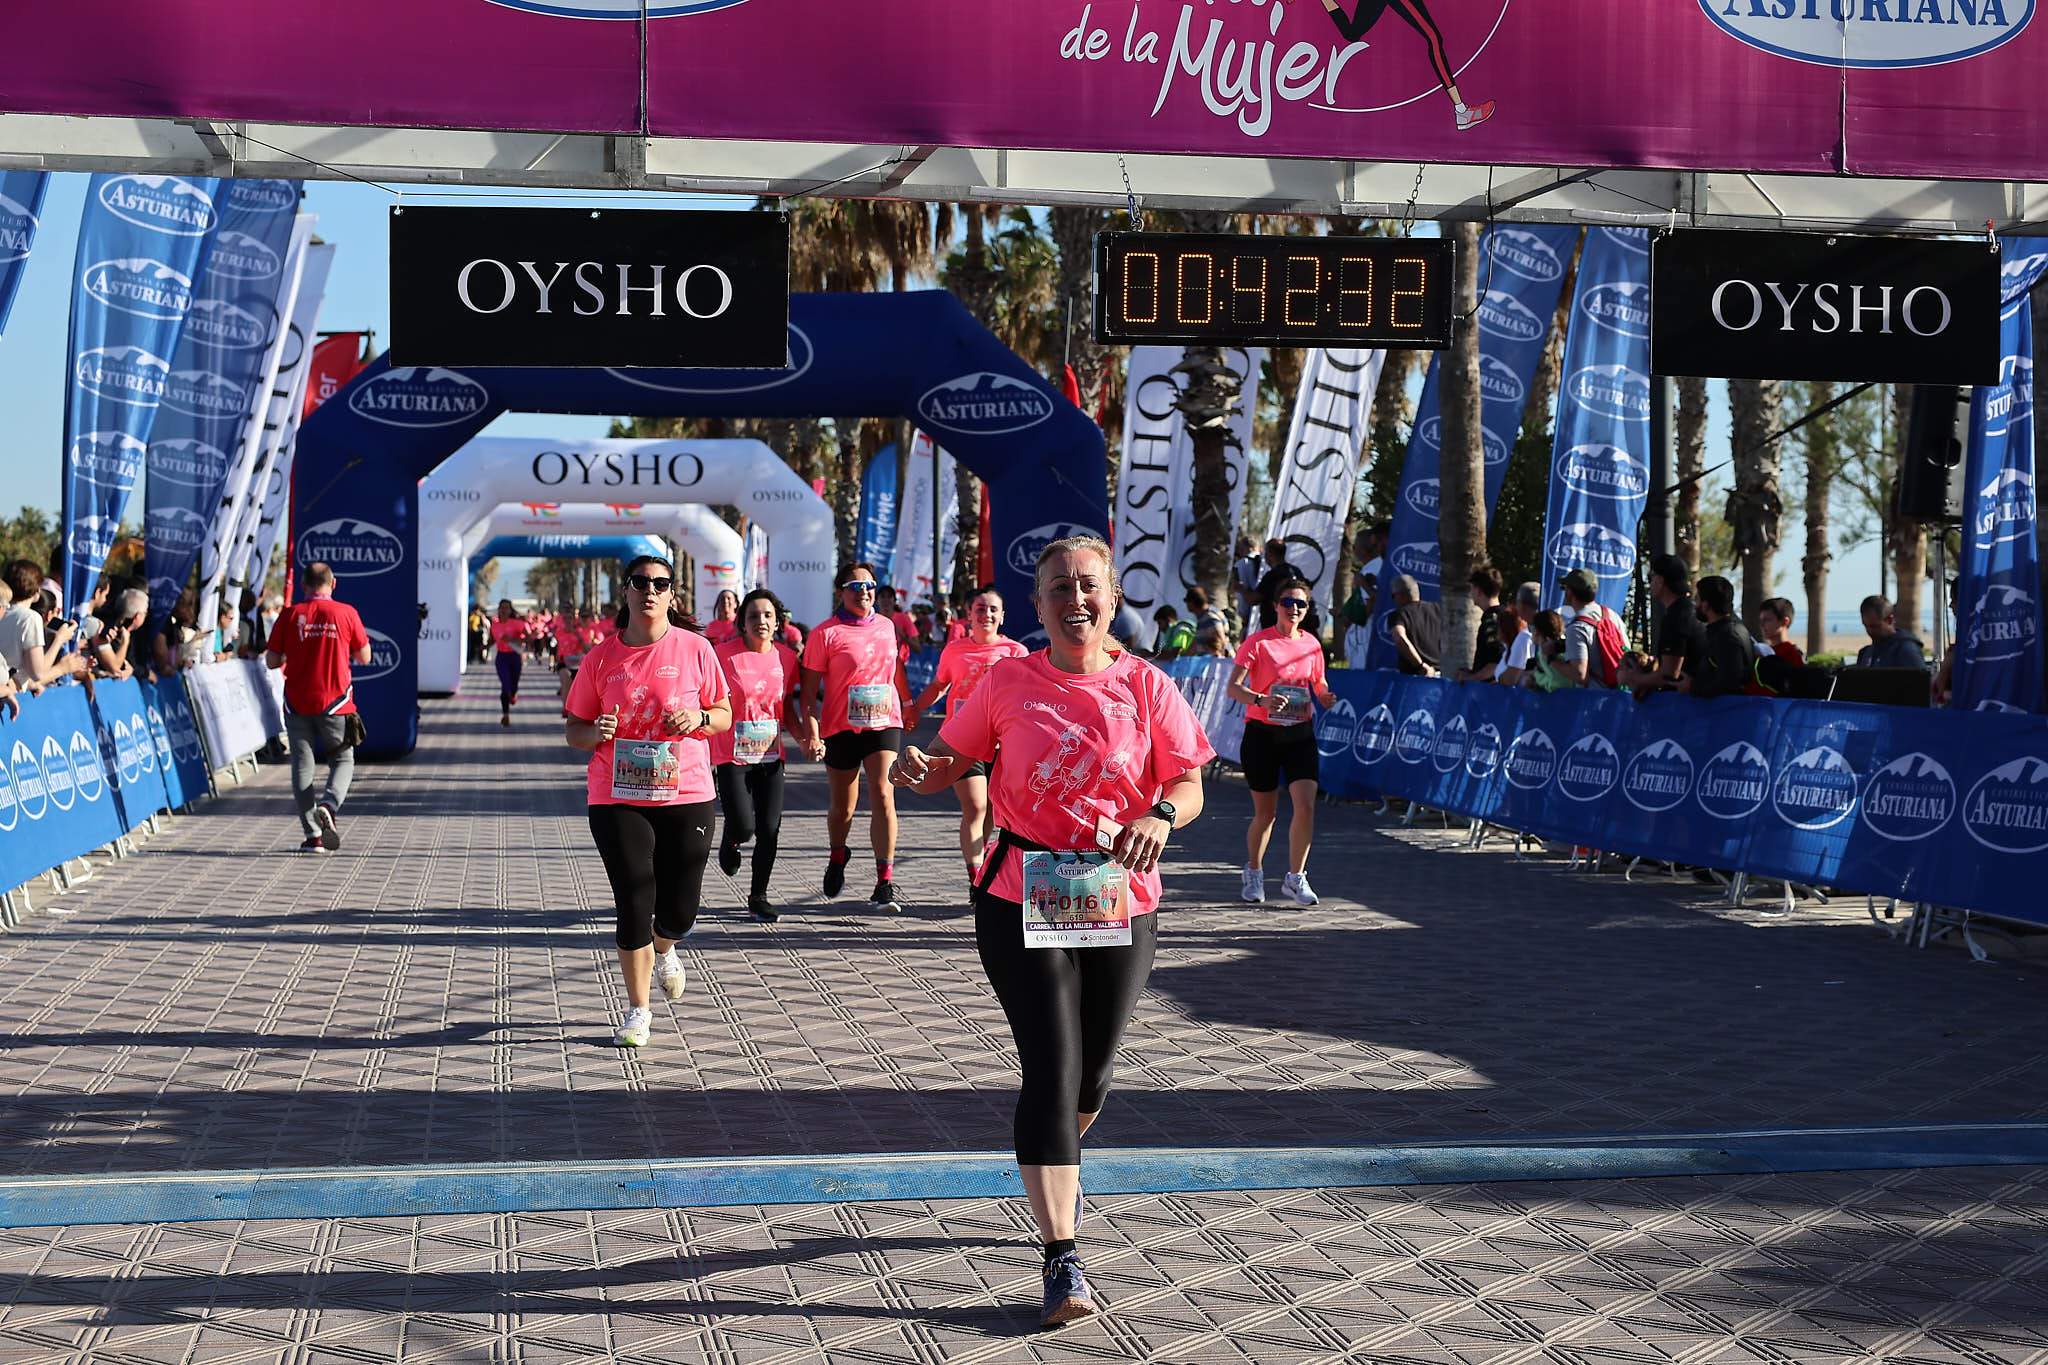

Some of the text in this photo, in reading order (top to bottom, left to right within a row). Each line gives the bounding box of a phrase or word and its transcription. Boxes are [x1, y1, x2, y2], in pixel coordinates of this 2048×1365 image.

[1060, 2, 1370, 136] de la Mujer
[457, 258, 733, 319] OYSHO
[1123, 252, 1427, 328] 00:42:32
[1711, 279, 1952, 337] OYSHO
[357, 386, 478, 412] ASTURIANA
[930, 397, 1045, 420] ASTURIANA
[532, 451, 704, 487] OYSHO
[1564, 456, 1643, 493] ASTURIANA
[428, 490, 481, 502] OYSHO
[752, 489, 804, 501] OYSHO
[1120, 374, 1182, 609] OYSHO
[302, 540, 397, 563] ASTURIANA
[778, 560, 827, 573] OYSHO
[1561, 757, 1613, 786] ASTURIANA
[1627, 764, 1687, 795] ASTURIANA
[1701, 768, 1763, 801] ASTURIANA
[1778, 772, 1850, 811] ASTURIANA
[1866, 782, 1946, 821] ASTURIANA
[1968, 788, 2048, 830] ASTURIA
[1058, 867, 1097, 876] ASTURIANA
[1059, 894, 1099, 911] 016
[1029, 923, 1055, 931] CARRERA
[1036, 934, 1068, 942] OYSHO
